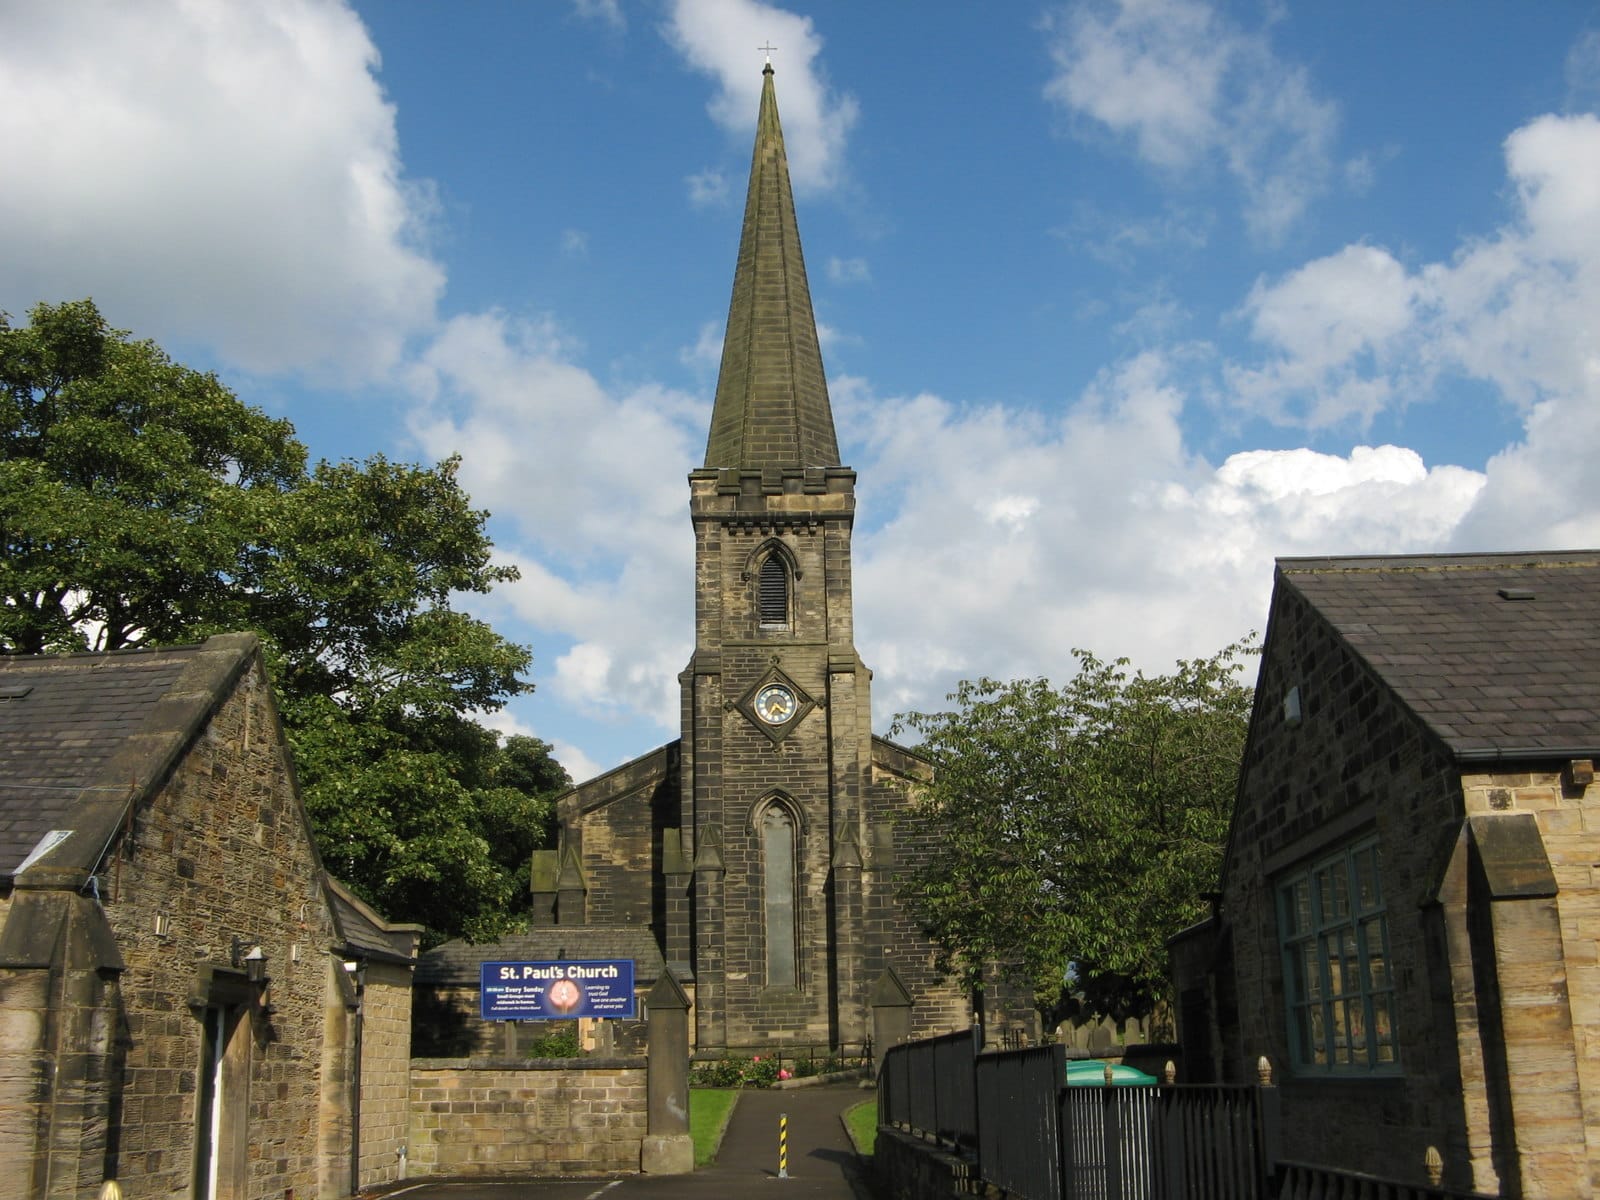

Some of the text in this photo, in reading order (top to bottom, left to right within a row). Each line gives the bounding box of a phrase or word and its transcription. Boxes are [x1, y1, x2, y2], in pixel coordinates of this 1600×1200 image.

[500, 965, 618, 979] St. Paul's Church
